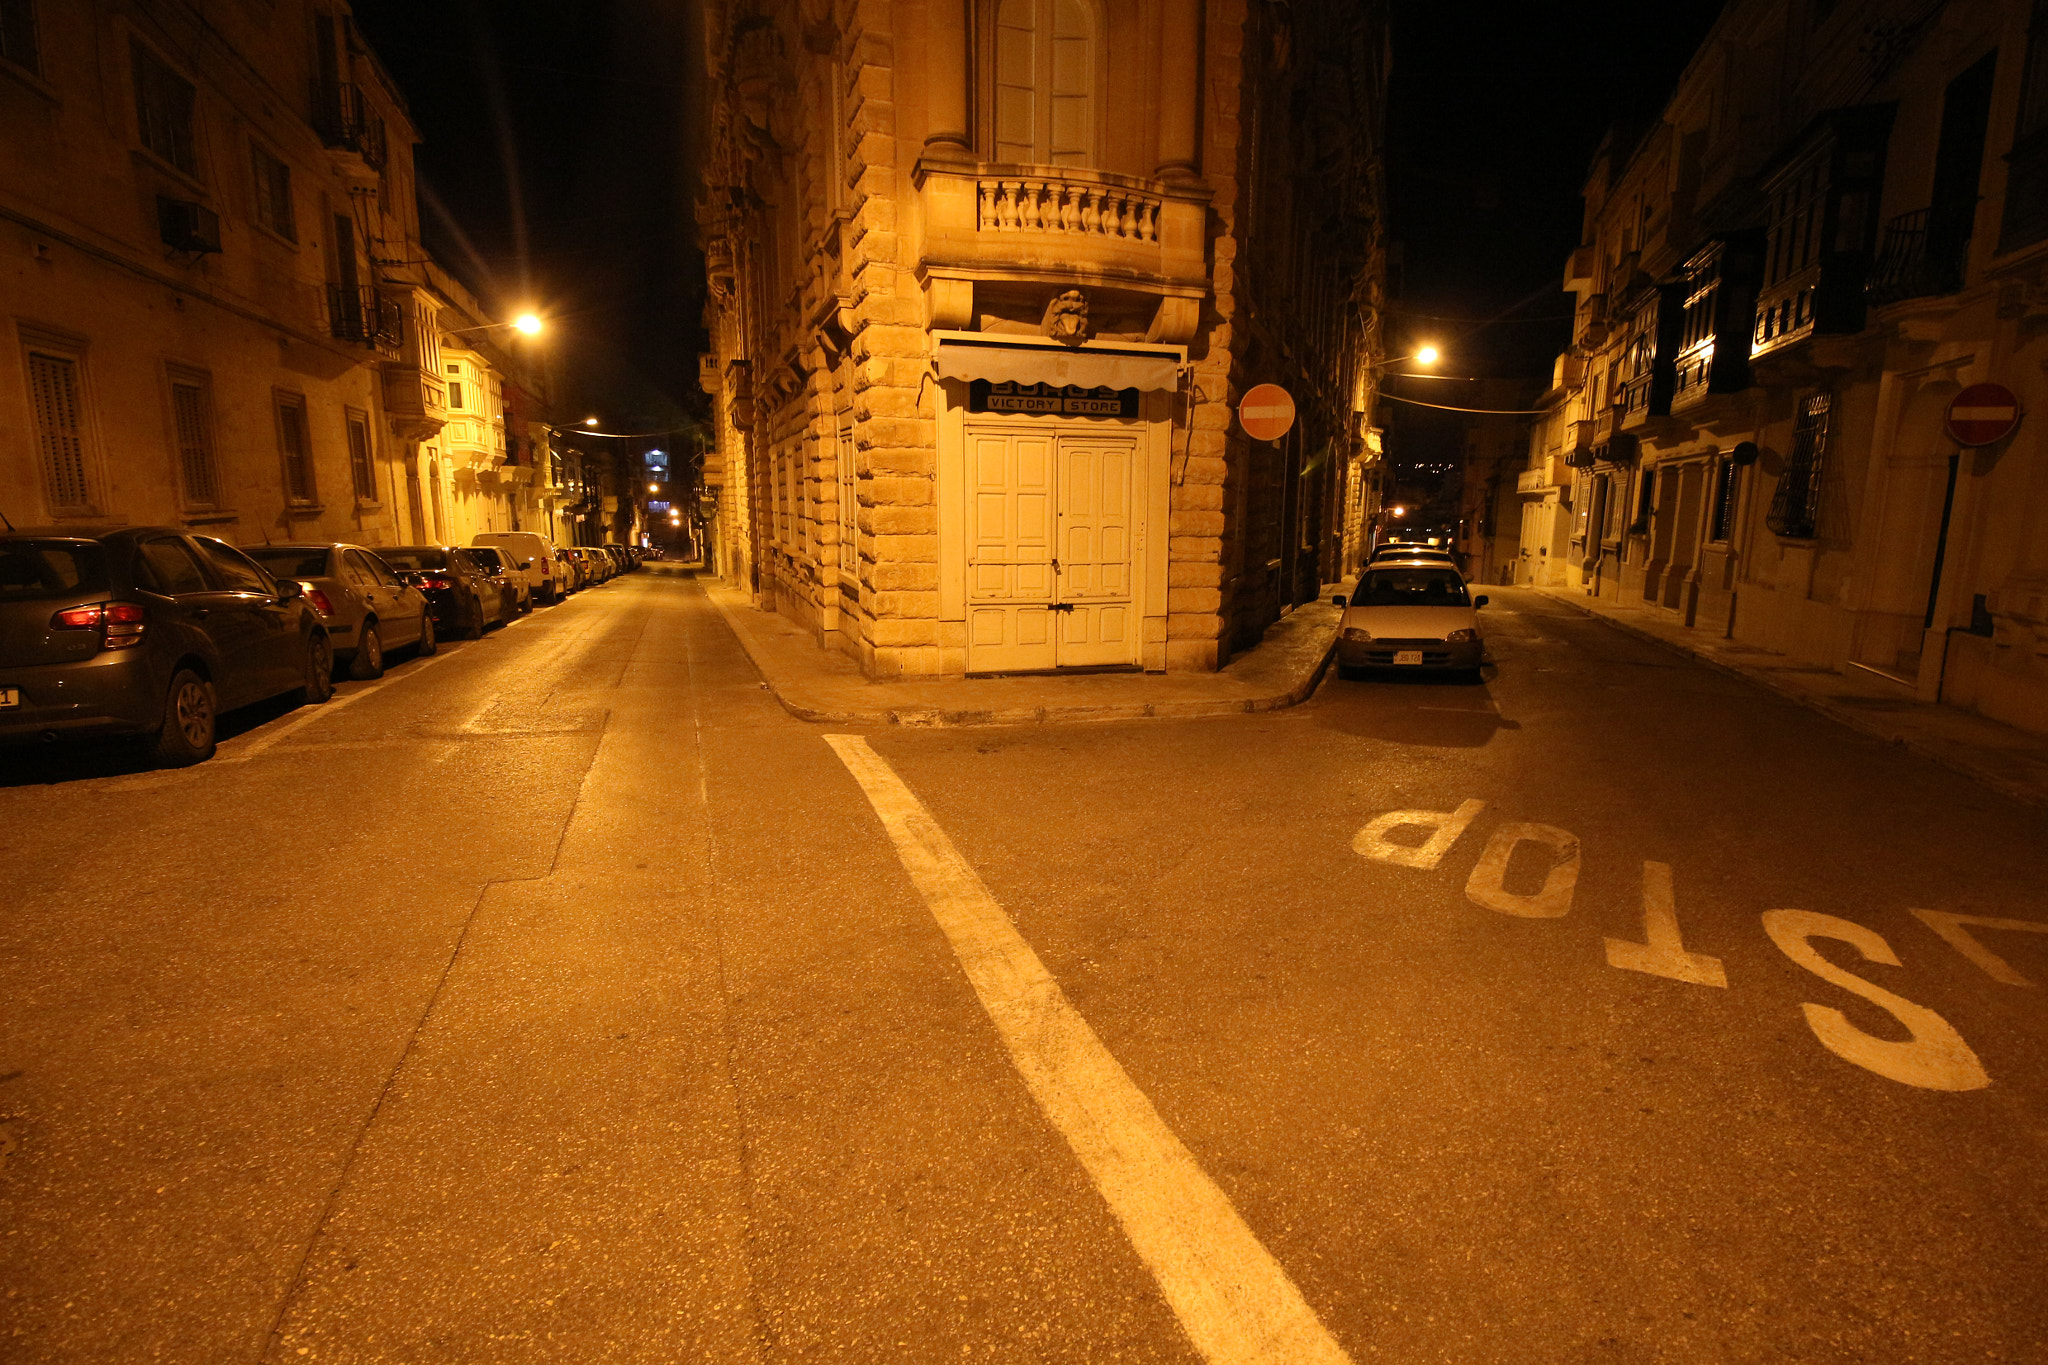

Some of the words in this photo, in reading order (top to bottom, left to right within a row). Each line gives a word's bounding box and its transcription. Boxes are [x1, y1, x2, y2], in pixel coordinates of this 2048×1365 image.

[992, 398, 1055, 409] VICTORY
[1071, 401, 1119, 411] STORE
[1351, 797, 1992, 1092] STOP
